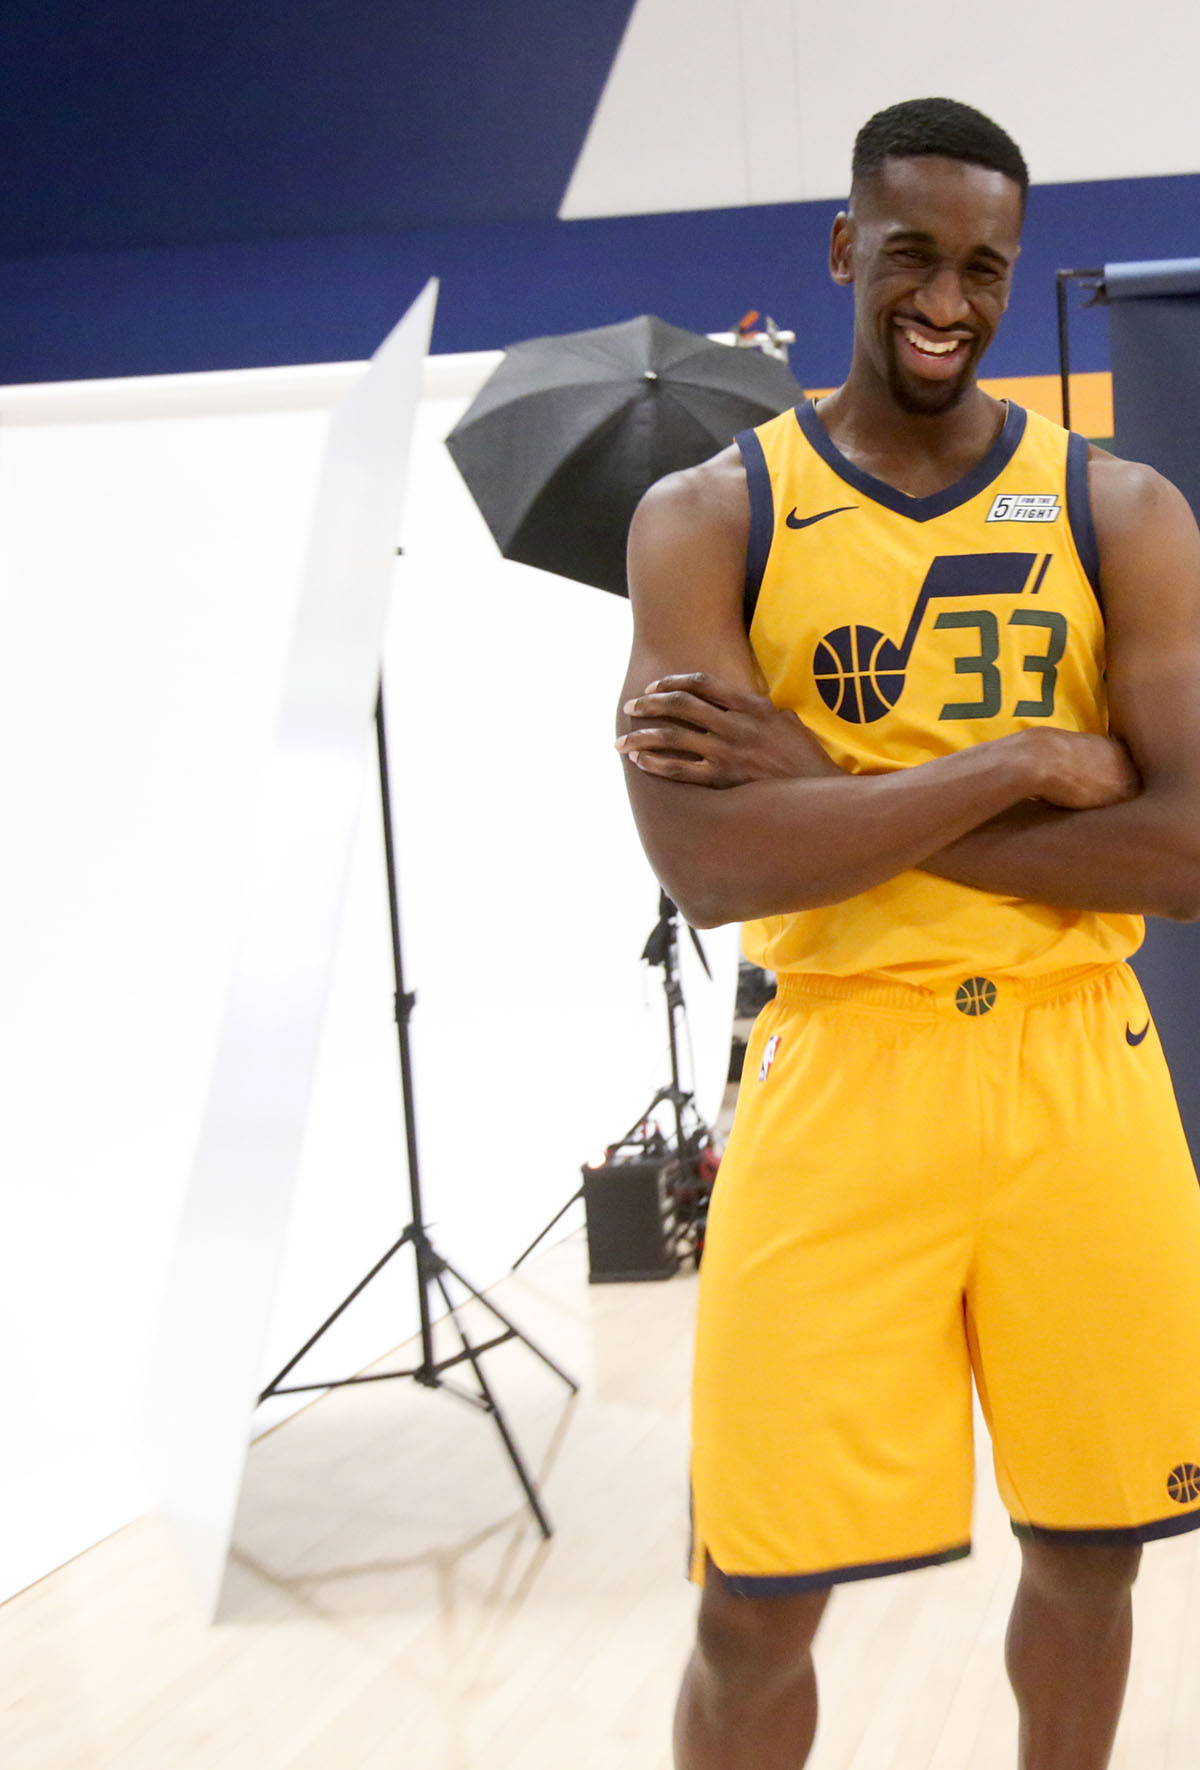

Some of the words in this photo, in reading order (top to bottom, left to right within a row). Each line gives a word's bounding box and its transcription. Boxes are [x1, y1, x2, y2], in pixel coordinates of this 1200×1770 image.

[994, 497, 1013, 518] 5
[1015, 508, 1054, 519] FIGHT
[933, 608, 1068, 721] 33
